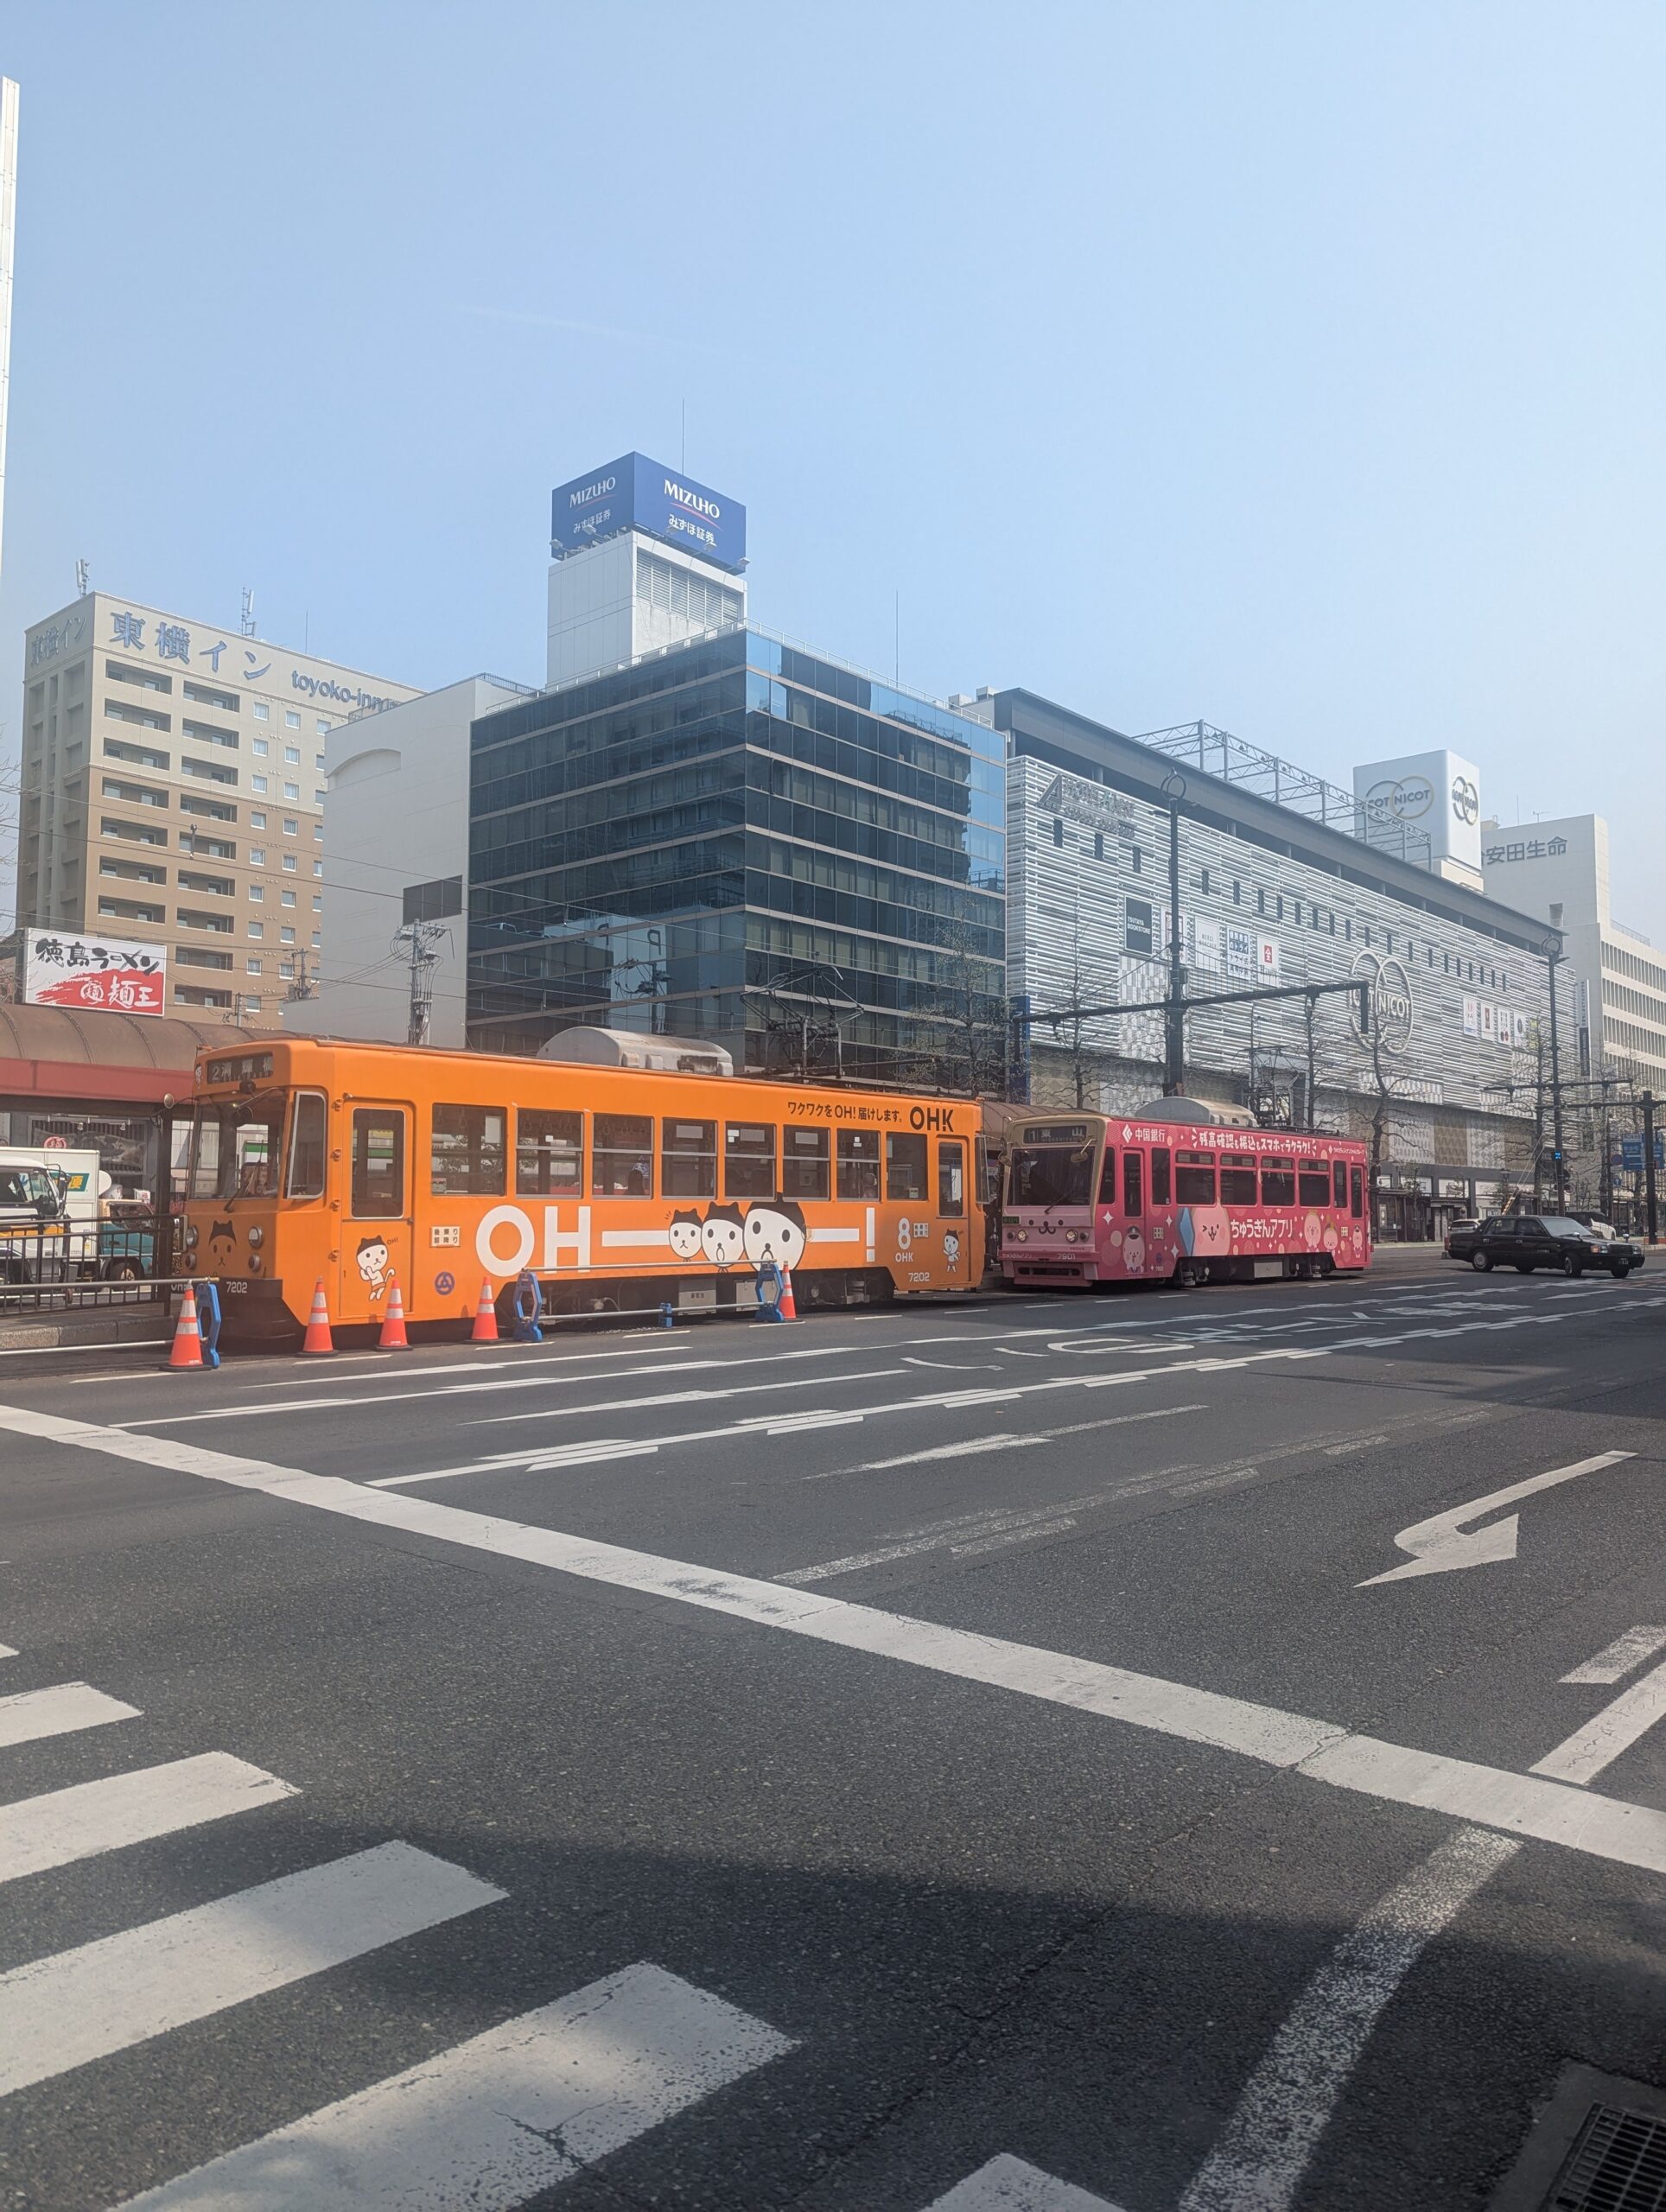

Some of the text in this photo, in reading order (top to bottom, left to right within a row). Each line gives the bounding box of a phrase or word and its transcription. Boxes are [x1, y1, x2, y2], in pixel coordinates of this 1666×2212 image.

[569, 476, 616, 509] MIZUHO
[664, 479, 721, 518] MIZUHO
[573, 509, 612, 534] みずほ証券
[668, 513, 716, 545] みずほ証券
[30, 615, 87, 666] 東横イン
[110, 610, 272, 680] 東横イン
[1394, 789, 1430, 805] NICOT
[1127, 916, 1145, 926] TSUTAYA
[1127, 923, 1151, 935] BOOKSTORE
[35, 938, 160, 976] 徳島ラーメン
[1377, 992, 1410, 1019] NICOT
[1030, 1130, 1036, 1141] 1
[1041, 1127, 1084, 1138] 東山
[1135, 1127, 1166, 1142] 中国銀行
[898, 1217, 911, 1250] 8
[1230, 1218, 1293, 1238] ちゅうぎんアプリ
[895, 1252, 913, 1262] OHK
[907, 1272, 931, 1282] 7202
[226, 1281, 248, 1294] 7202
